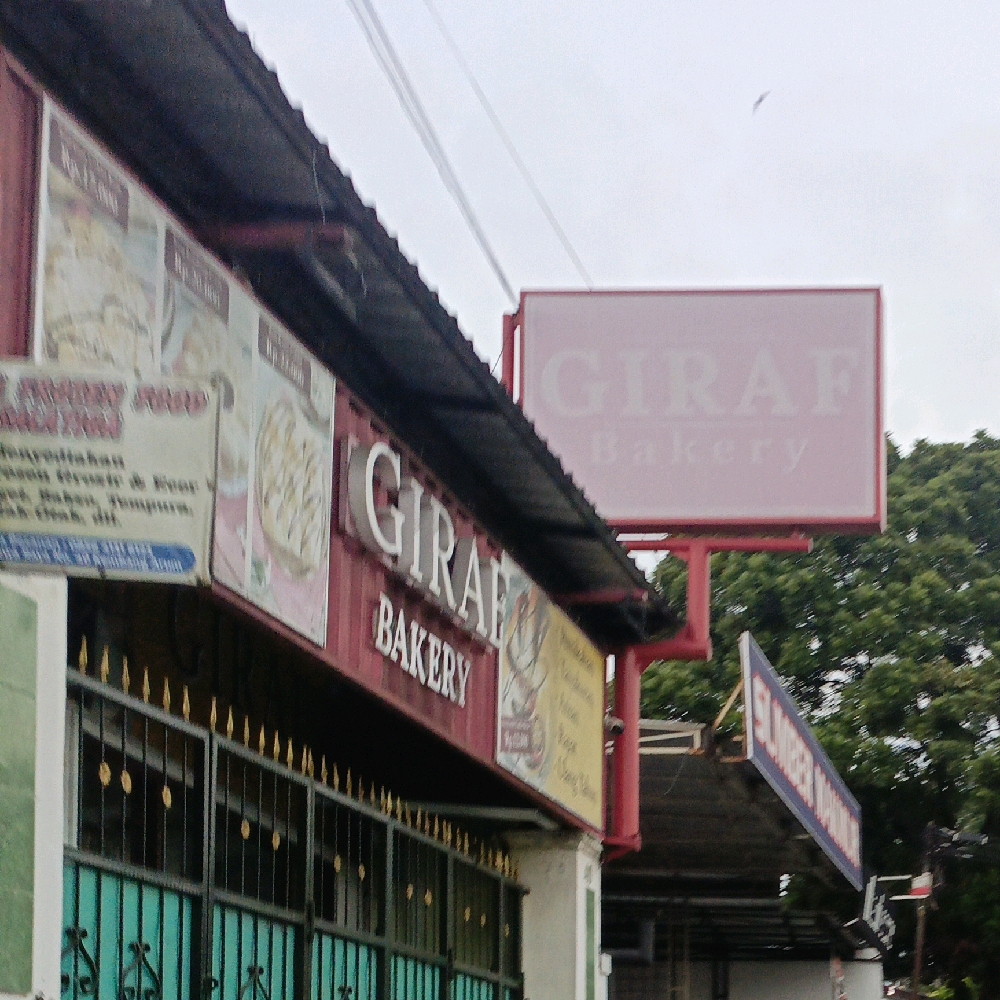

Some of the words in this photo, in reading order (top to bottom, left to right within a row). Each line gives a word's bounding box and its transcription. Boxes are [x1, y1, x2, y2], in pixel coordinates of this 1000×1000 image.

[541, 347, 858, 418] GIRAF
[591, 432, 809, 473] Bakery
[374, 591, 472, 709] BAKERY
[752, 672, 814, 810] SUMBER
